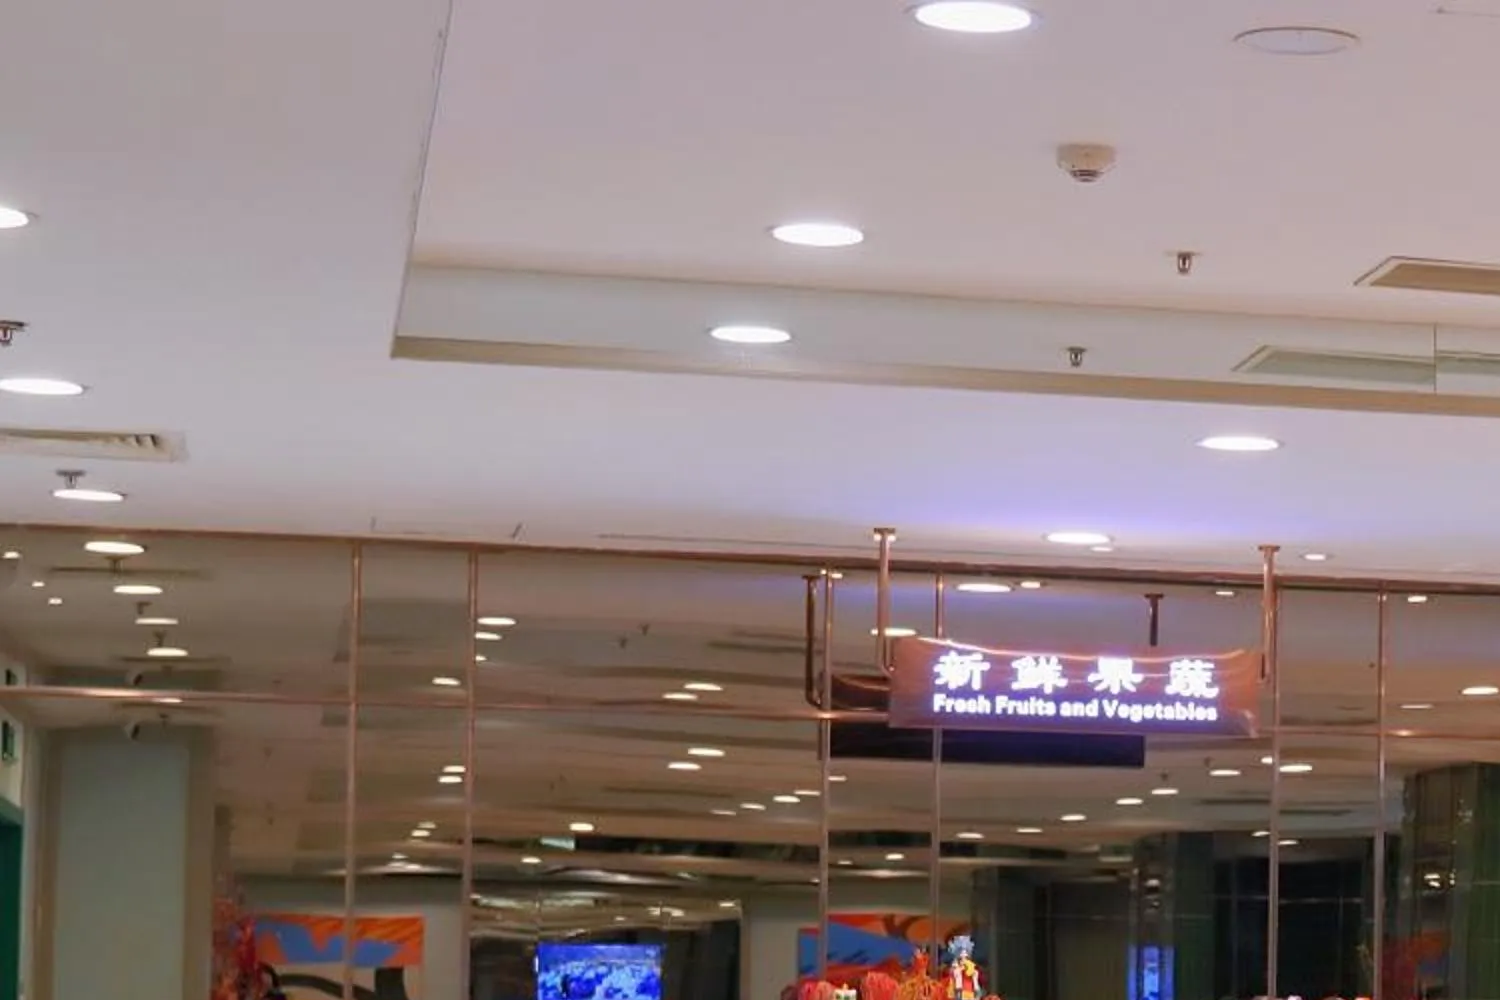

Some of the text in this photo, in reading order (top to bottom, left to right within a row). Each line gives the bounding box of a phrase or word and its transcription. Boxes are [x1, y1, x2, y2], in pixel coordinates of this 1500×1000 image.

[933, 650, 1219, 698] 新鲜果蔬
[933, 694, 1218, 722] Fresh Fruits and Vegetables
